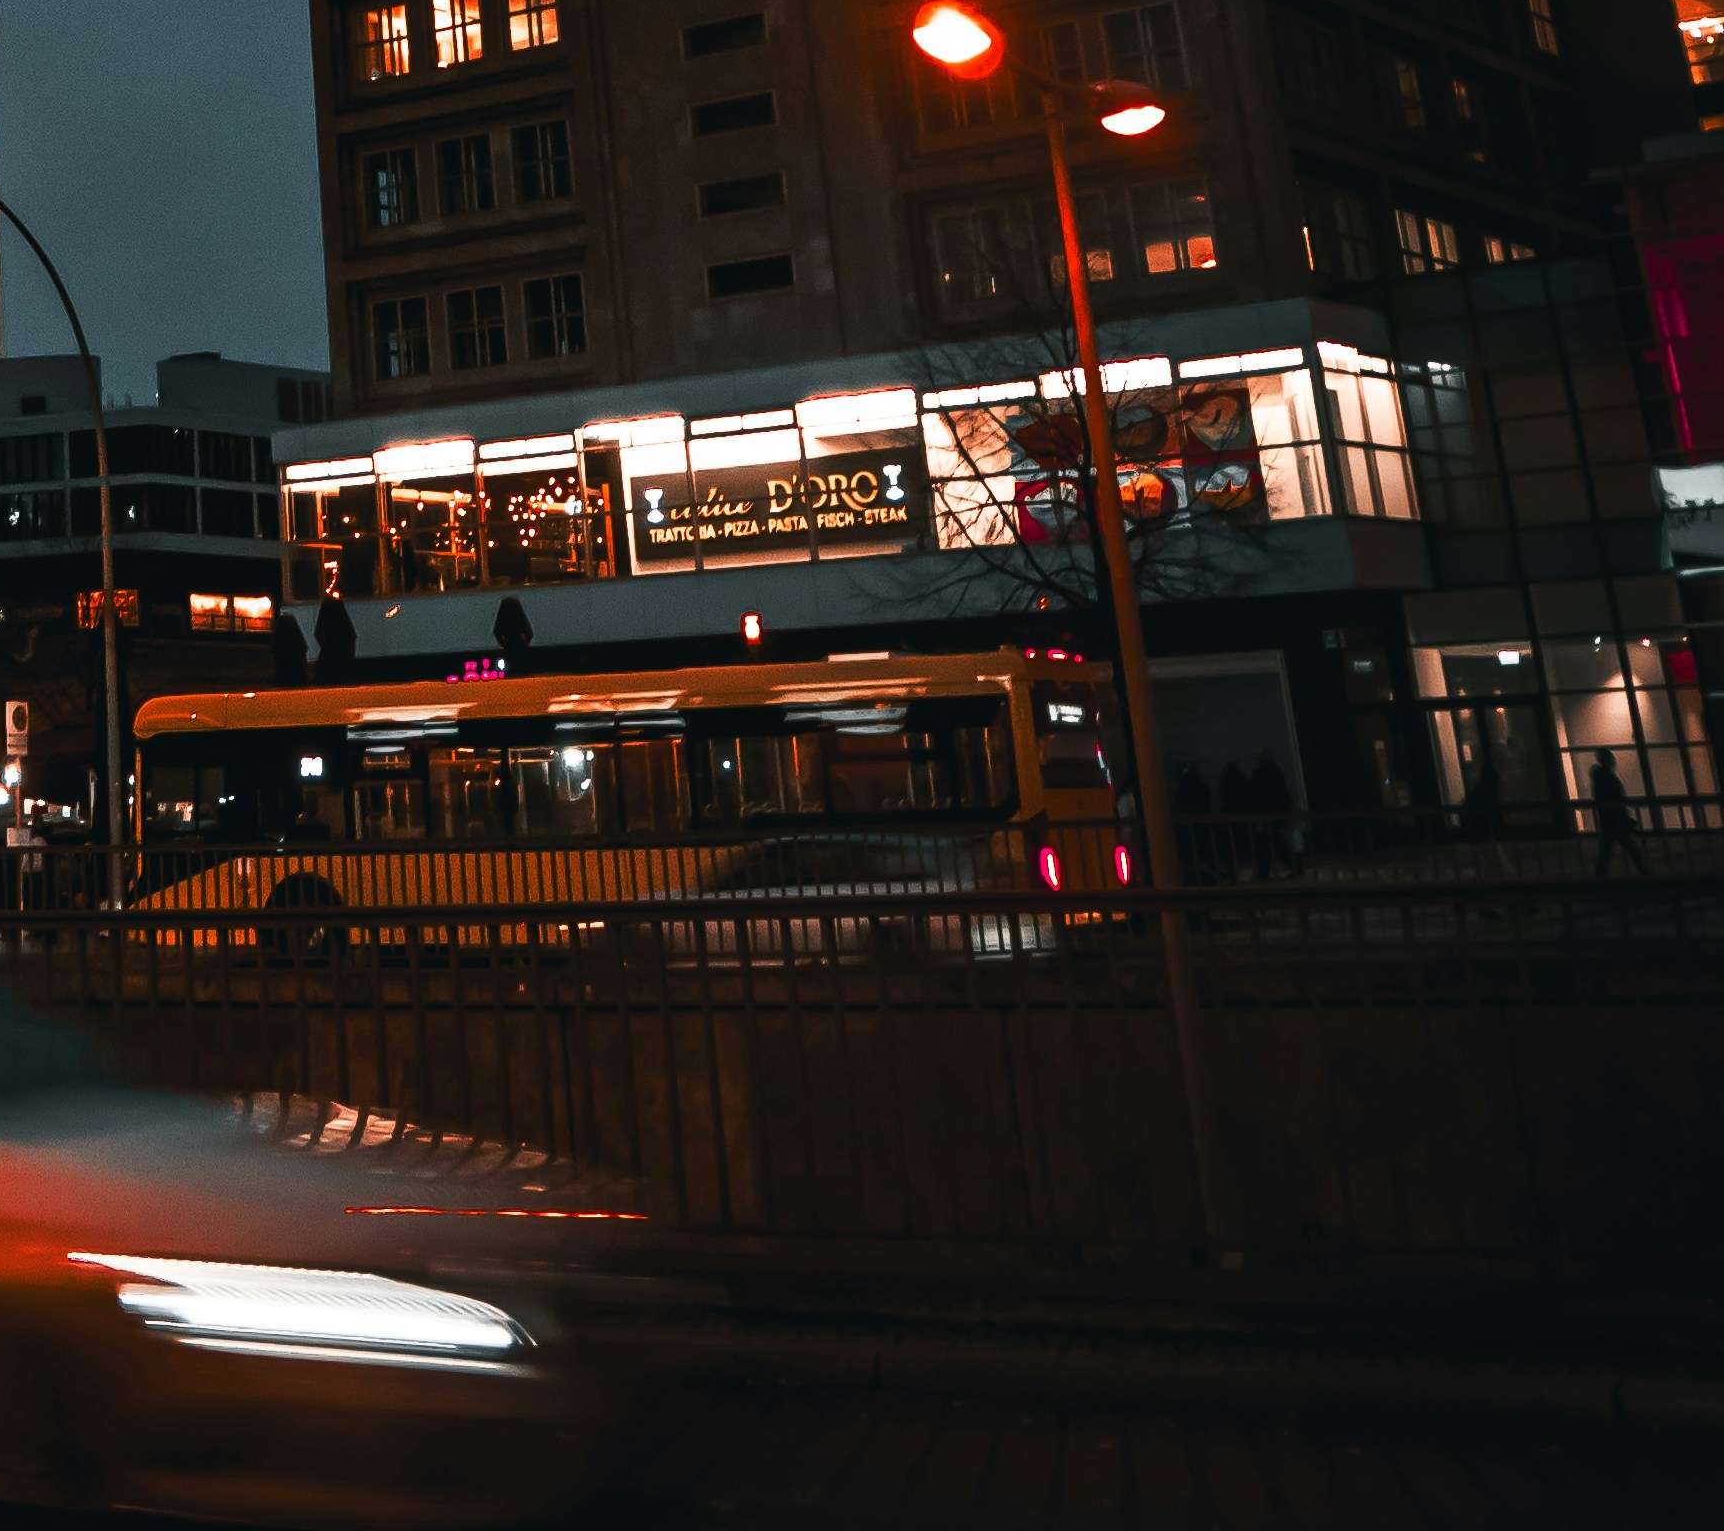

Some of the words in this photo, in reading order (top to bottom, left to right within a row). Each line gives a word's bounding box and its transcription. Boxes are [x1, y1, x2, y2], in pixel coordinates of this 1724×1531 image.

[766, 471, 879, 513] D'ORO
[723, 519, 760, 538] PIZZA
[767, 515, 809, 534] PASTA
[816, 511, 855, 529] FISCH
[864, 506, 908, 525] STEAK
